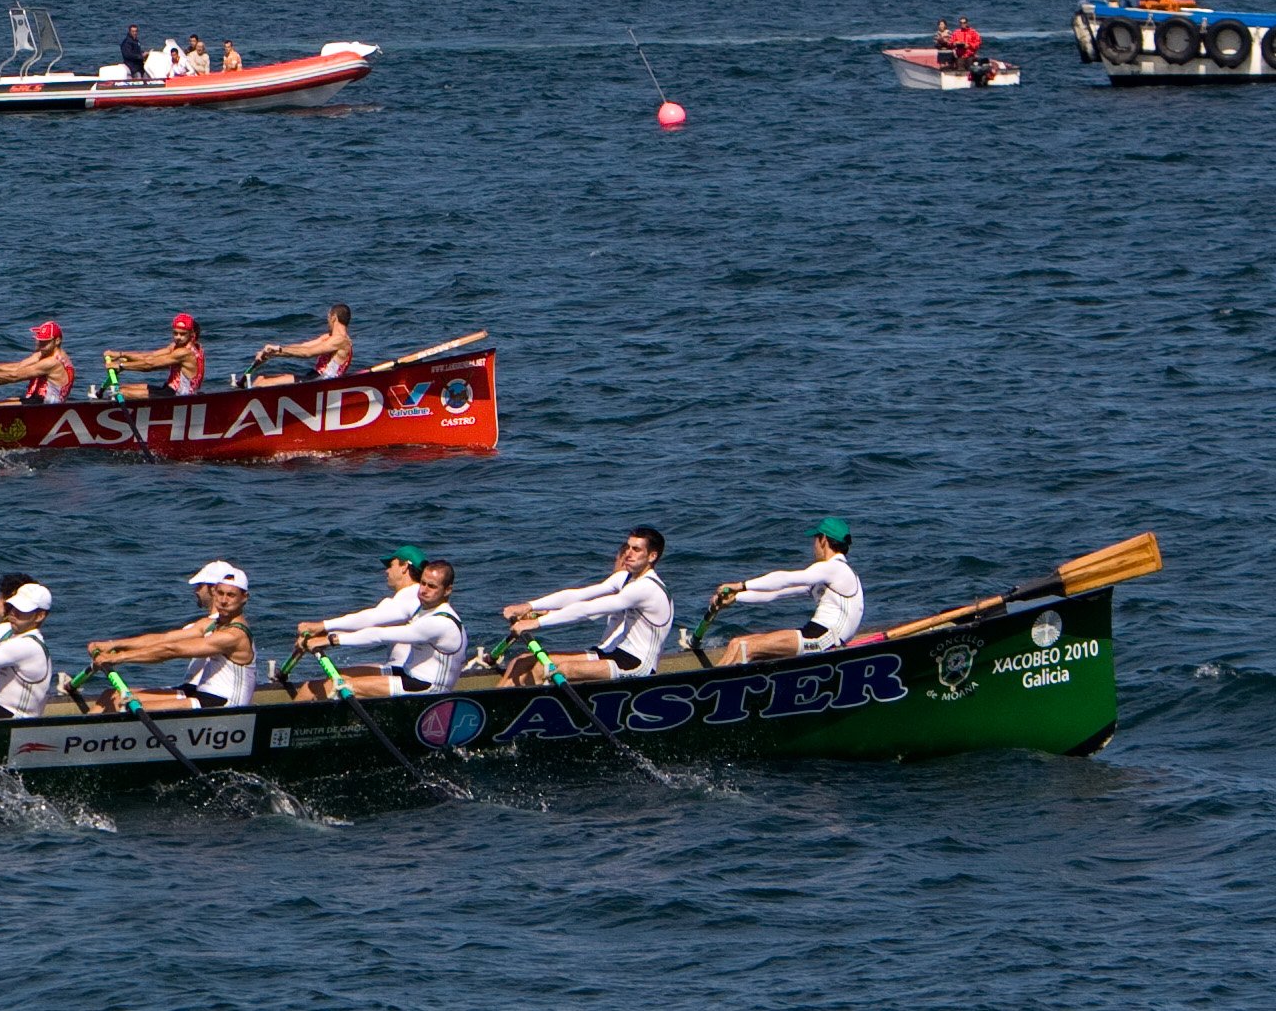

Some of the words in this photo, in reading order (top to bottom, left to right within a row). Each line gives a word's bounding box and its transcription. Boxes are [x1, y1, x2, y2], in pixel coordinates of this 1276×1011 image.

[39, 385, 385, 447] ASHLAND
[388, 407, 431, 418] Valvoline
[441, 416, 476, 427] CASTRO
[992, 647, 1061, 675] XACOBEO
[1064, 639, 1099, 661] 2010
[1022, 667, 1070, 689] Galicia
[492, 653, 909, 742] AISTER
[64, 734, 137, 755] Porto
[145, 732, 178, 749] de
[187, 727, 247, 750] Vigo
